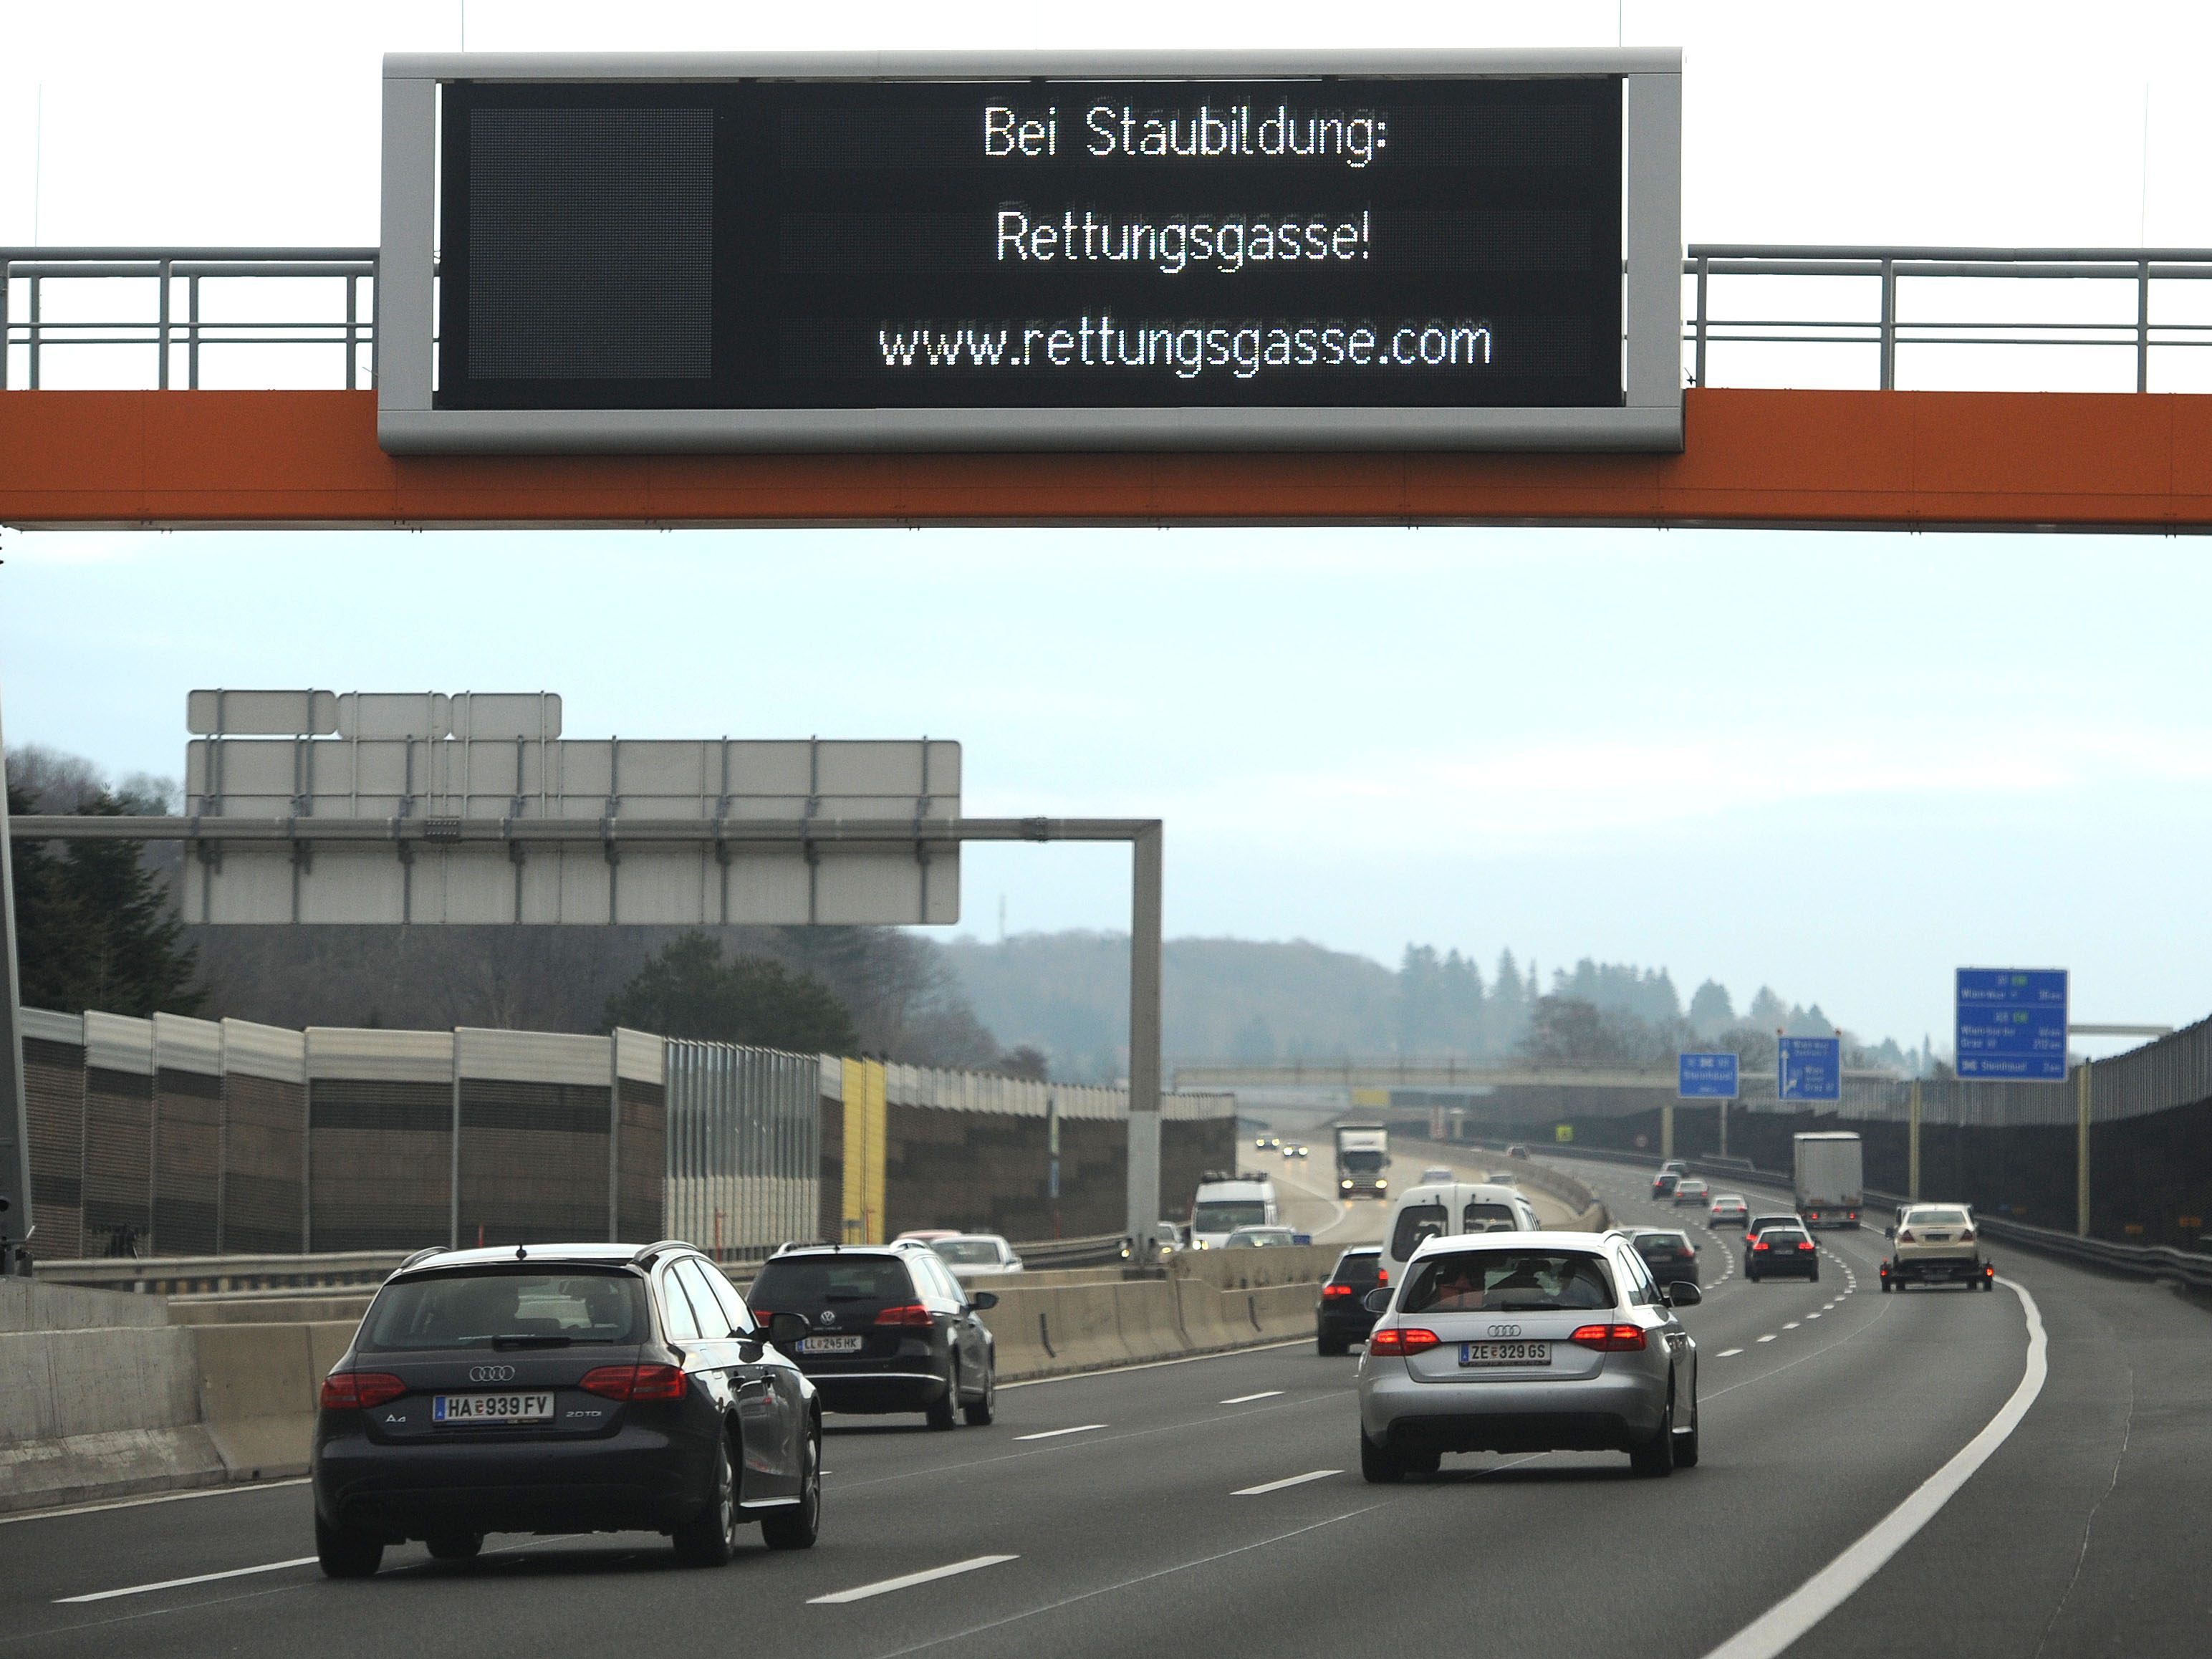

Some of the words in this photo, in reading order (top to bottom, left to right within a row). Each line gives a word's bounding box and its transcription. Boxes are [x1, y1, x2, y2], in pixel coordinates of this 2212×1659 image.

[984, 105, 1057, 156] Bei
[1086, 105, 1387, 168] Staubildung:
[997, 210, 1370, 273] Rettungsgasse!
[878, 315, 1492, 378] www.rettungsgasse.com
[1471, 1345, 1489, 1360] ZE
[1499, 1344, 1525, 1359] 329
[1527, 1343, 1546, 1358] GS
[448, 1398, 473, 1418] HA
[486, 1397, 520, 1416] 939
[524, 1396, 547, 1415] FV
